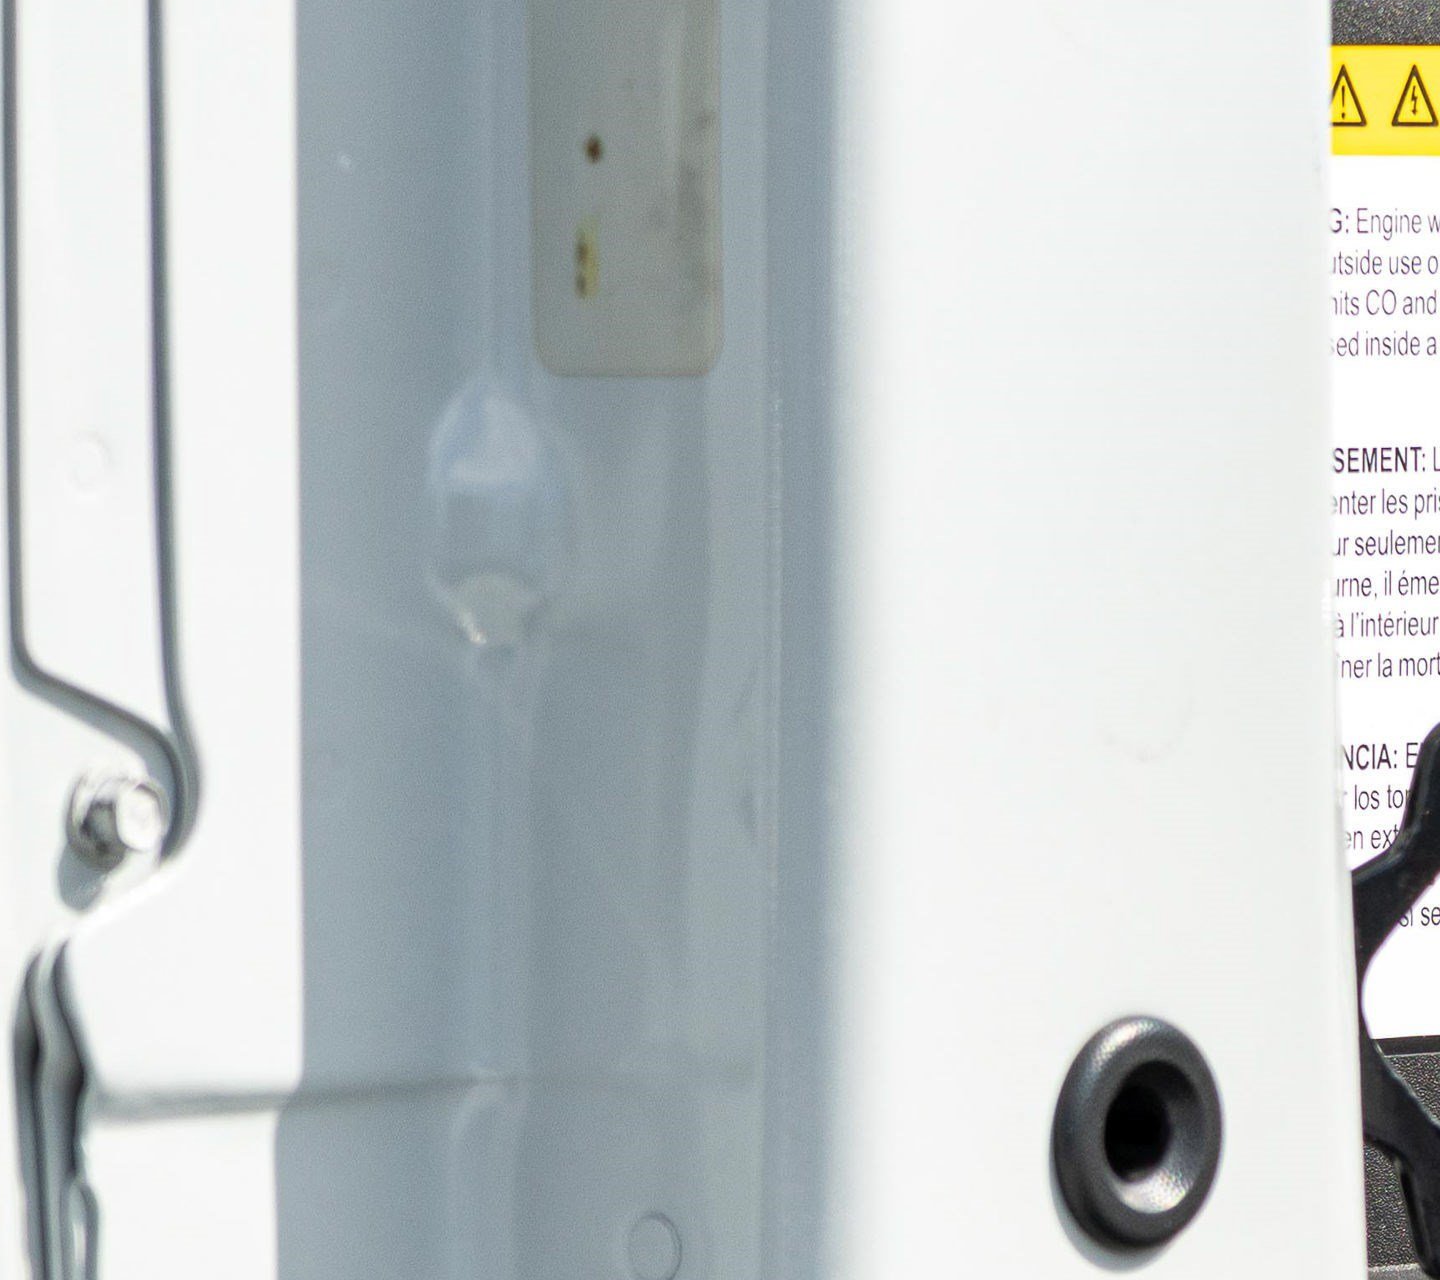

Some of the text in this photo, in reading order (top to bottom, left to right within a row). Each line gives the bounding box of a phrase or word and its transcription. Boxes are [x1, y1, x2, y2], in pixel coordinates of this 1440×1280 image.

[1357, 208, 1421, 241] Engine
[1389, 256, 1421, 275] use
[1366, 289, 1396, 315] CO
[1403, 290, 1436, 315] and
[1366, 331, 1420, 356] inside
[1427, 337, 1436, 356] a
[1333, 446, 1425, 474] SEMENT:
[1382, 488, 1408, 514] les
[1385, 570, 1391, 596] il
[1378, 653, 1392, 677] la
[1355, 784, 1379, 810] los
[1421, 907, 1440, 926] se
